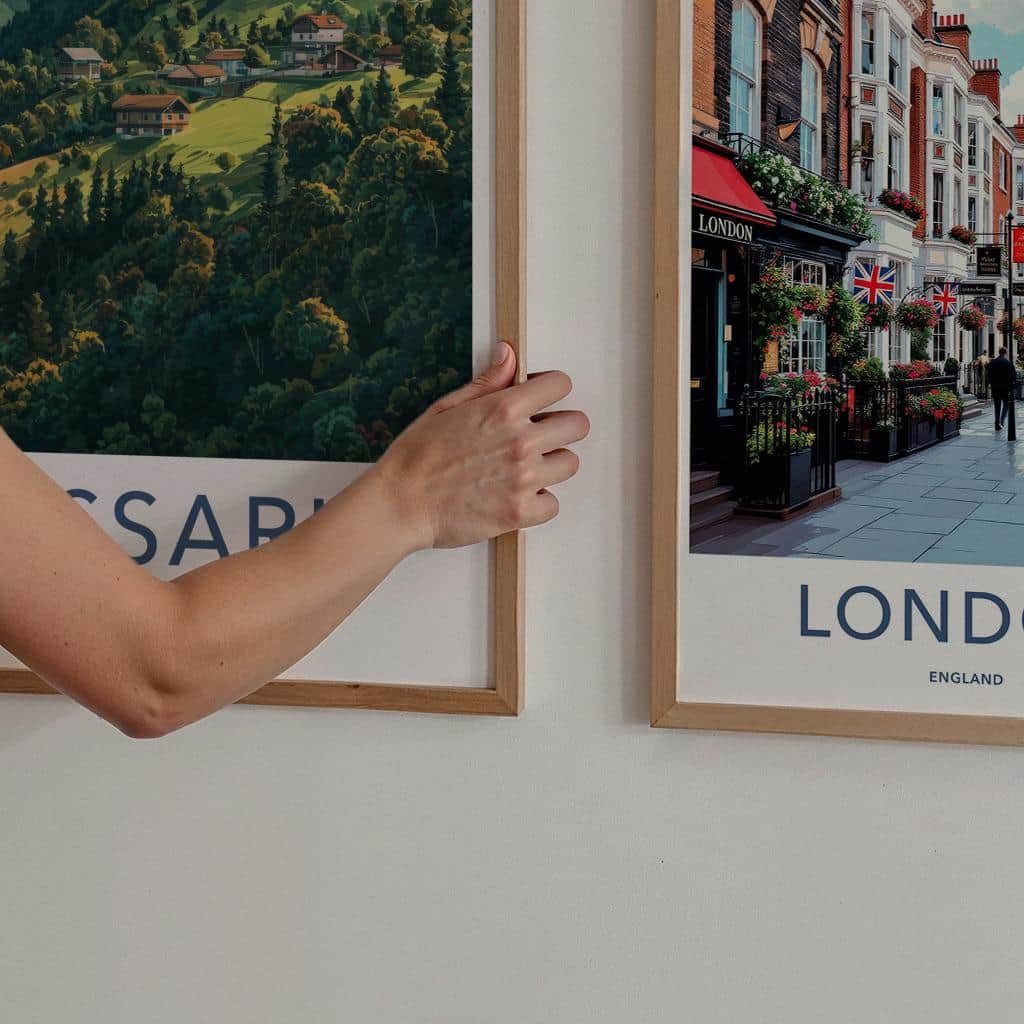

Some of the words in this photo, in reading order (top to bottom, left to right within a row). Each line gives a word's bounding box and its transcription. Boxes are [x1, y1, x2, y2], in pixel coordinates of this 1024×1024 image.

[699, 213, 753, 242] LONDON
[800, 584, 1024, 645] LOND
[929, 671, 1004, 686] ENGLAND
